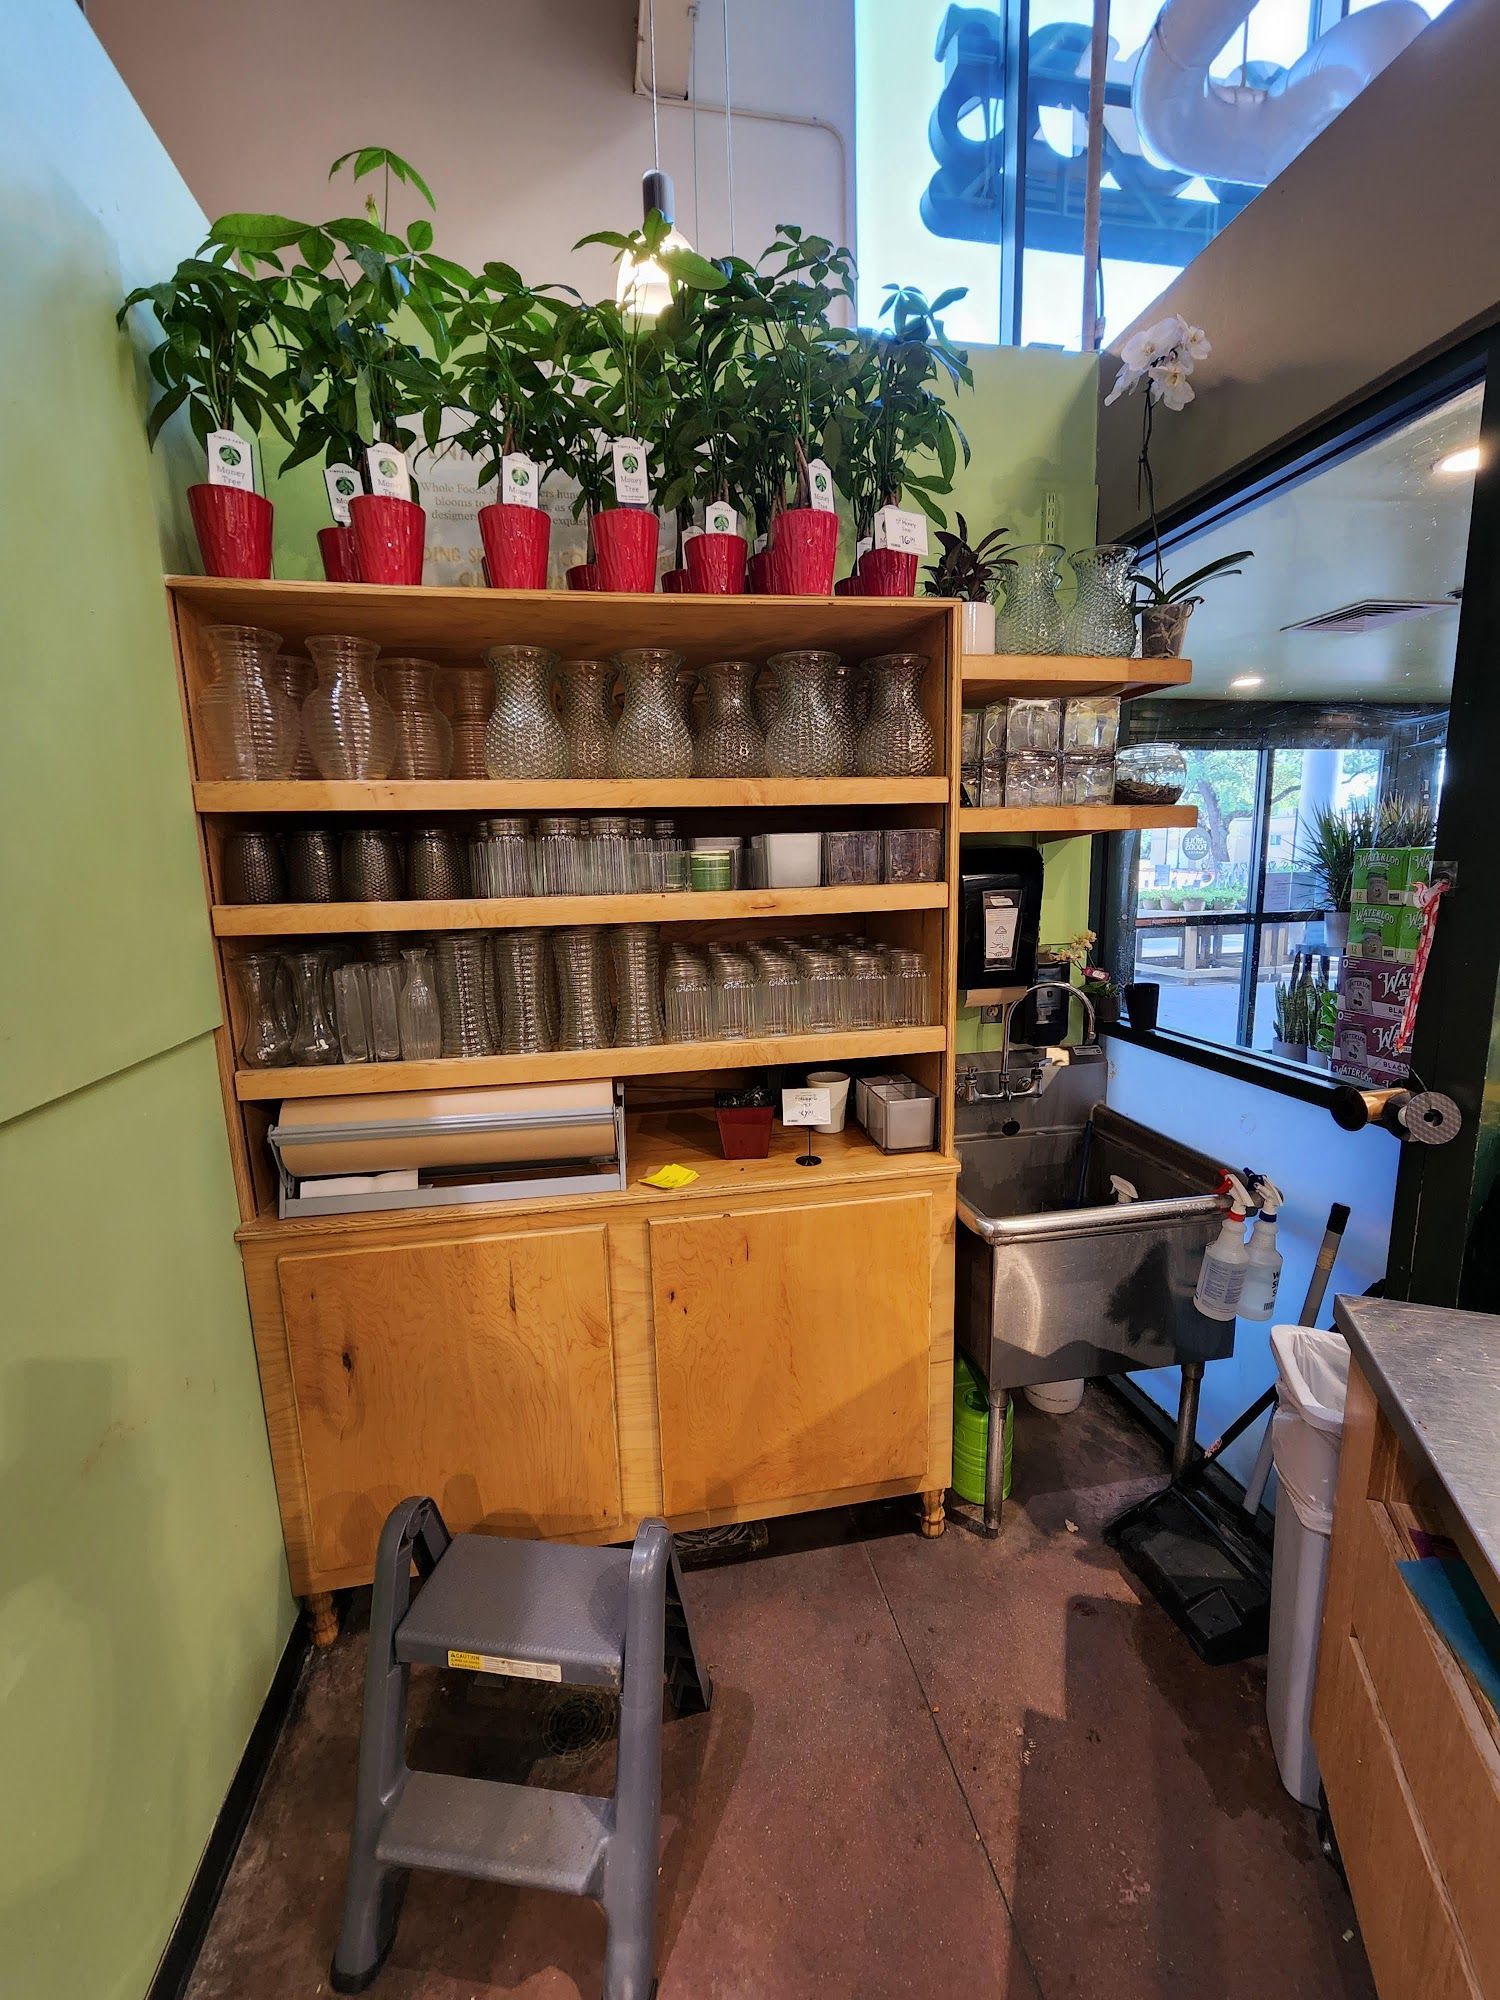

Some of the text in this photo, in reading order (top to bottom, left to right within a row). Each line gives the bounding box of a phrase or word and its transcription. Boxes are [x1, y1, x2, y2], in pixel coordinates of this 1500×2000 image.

[216, 465, 246, 479] Money
[221, 475, 242, 486] Tree
[620, 475, 642, 485] Money
[420, 482, 454, 493] Whole
[508, 485, 532, 498] Money
[435, 496, 472, 508] blooms
[1356, 851, 1400, 869] WATERLOO
[1353, 907, 1395, 925] WATERLOO
[1333, 1063, 1373, 1083] WATERLOO
[1383, 1061, 1407, 1073] BLACK
